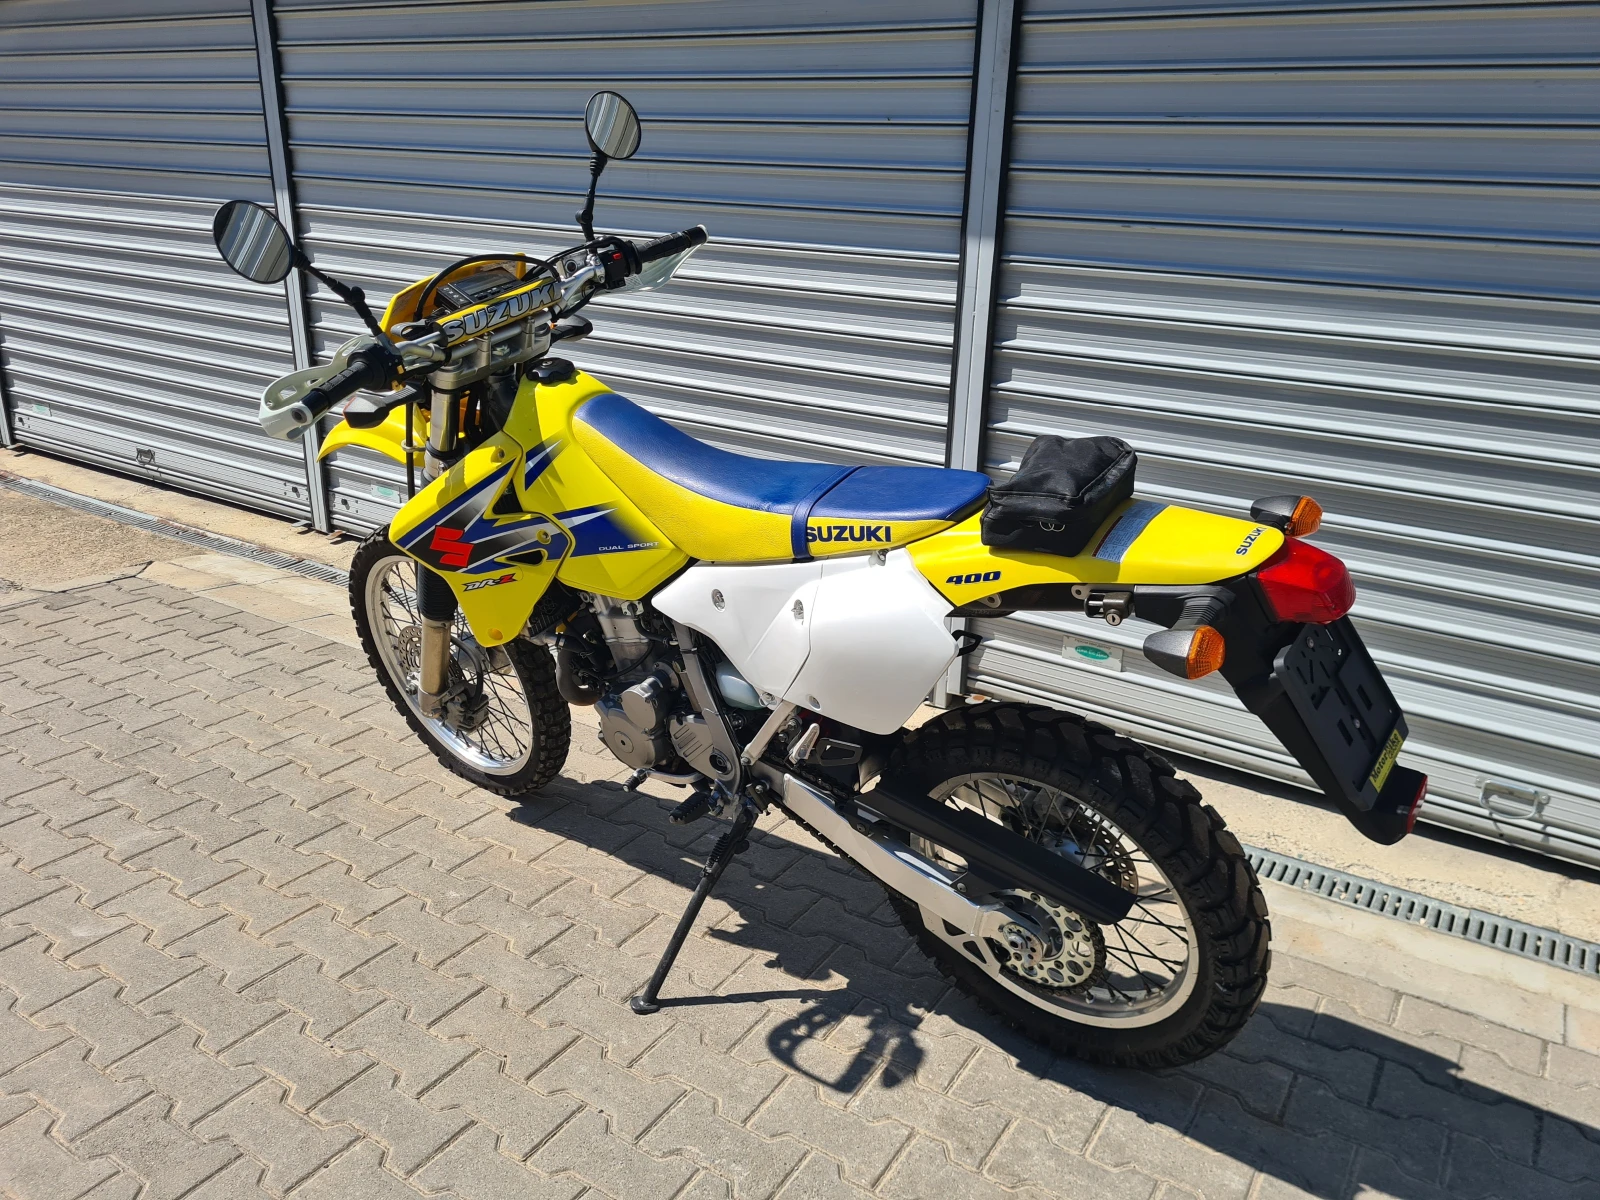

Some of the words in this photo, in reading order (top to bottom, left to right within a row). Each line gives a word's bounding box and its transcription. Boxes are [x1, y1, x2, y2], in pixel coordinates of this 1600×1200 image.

[442, 282, 562, 343] SUZUKI
[807, 525, 891, 542] SUZUKI
[1236, 526, 1266, 555] SUZUKI
[627, 541, 660, 549] SPORT
[463, 573, 517, 591] DR-Z
[946, 571, 1001, 585] 400
